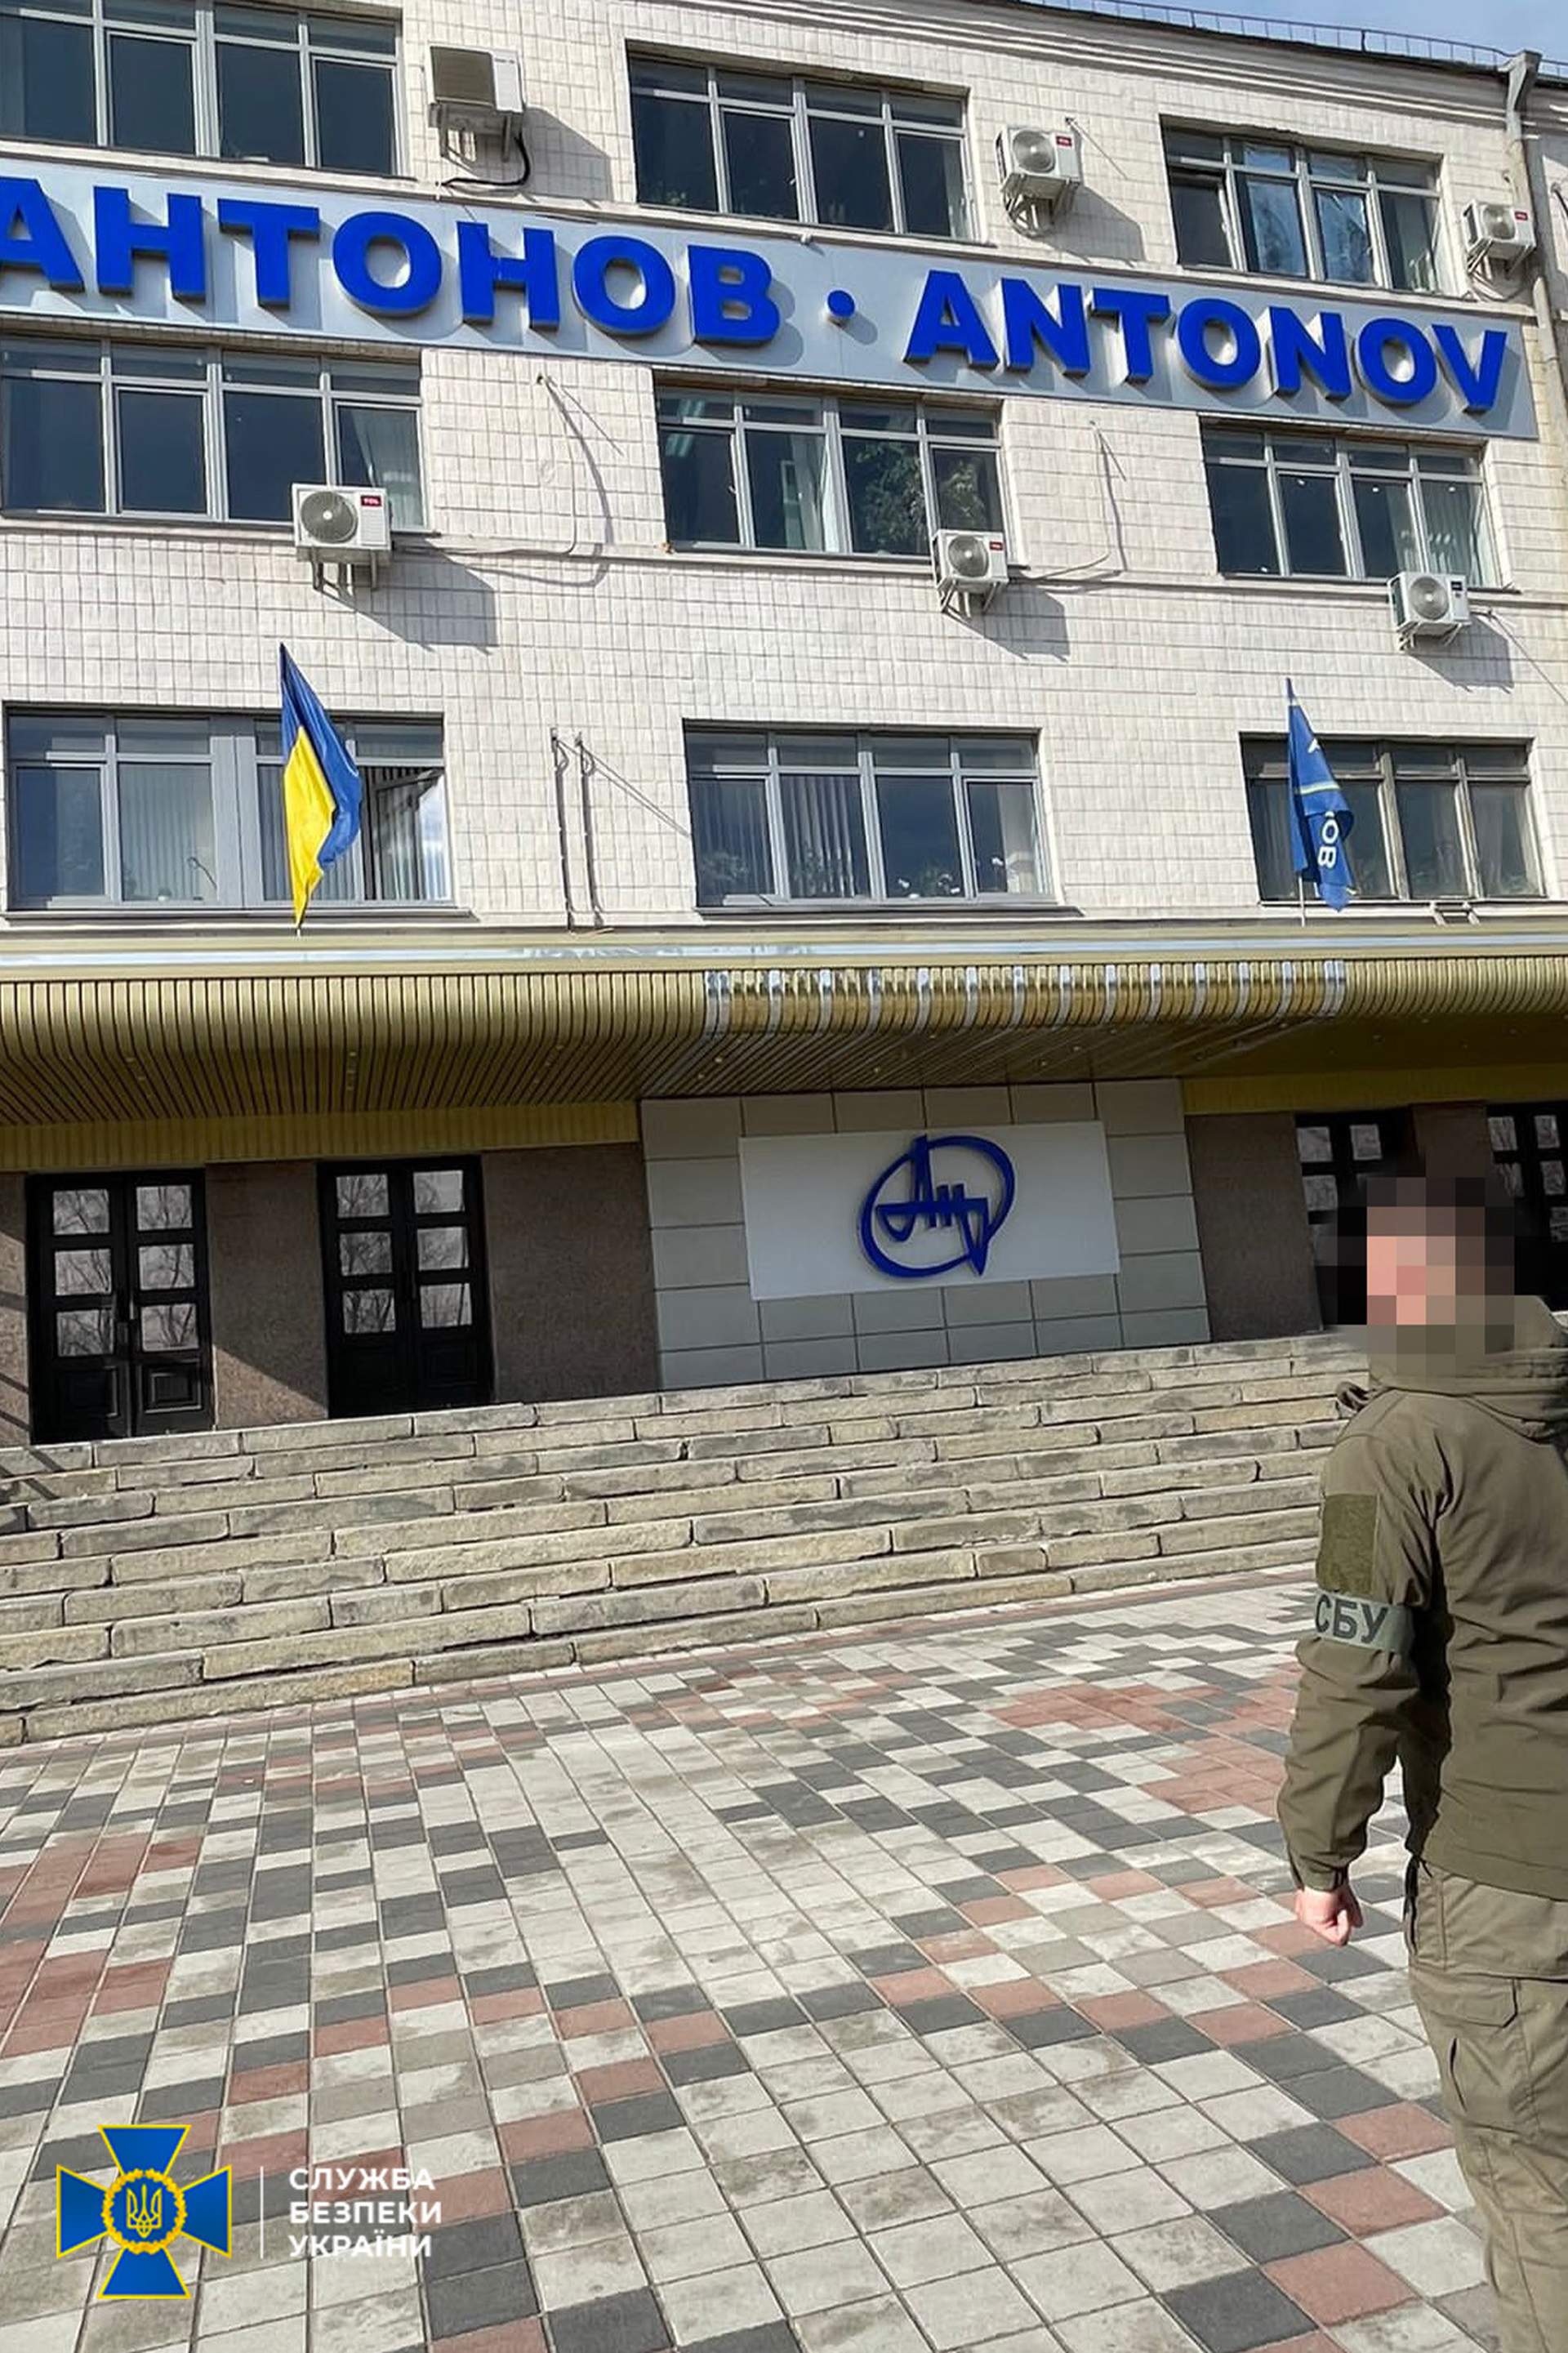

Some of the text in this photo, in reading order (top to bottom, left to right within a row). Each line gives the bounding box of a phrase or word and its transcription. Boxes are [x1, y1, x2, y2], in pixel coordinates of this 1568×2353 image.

[0, 176, 780, 345] АНТОНОВ
[903, 269, 1508, 413] ANTONOV
[1316, 1594, 1388, 1643] СБУ
